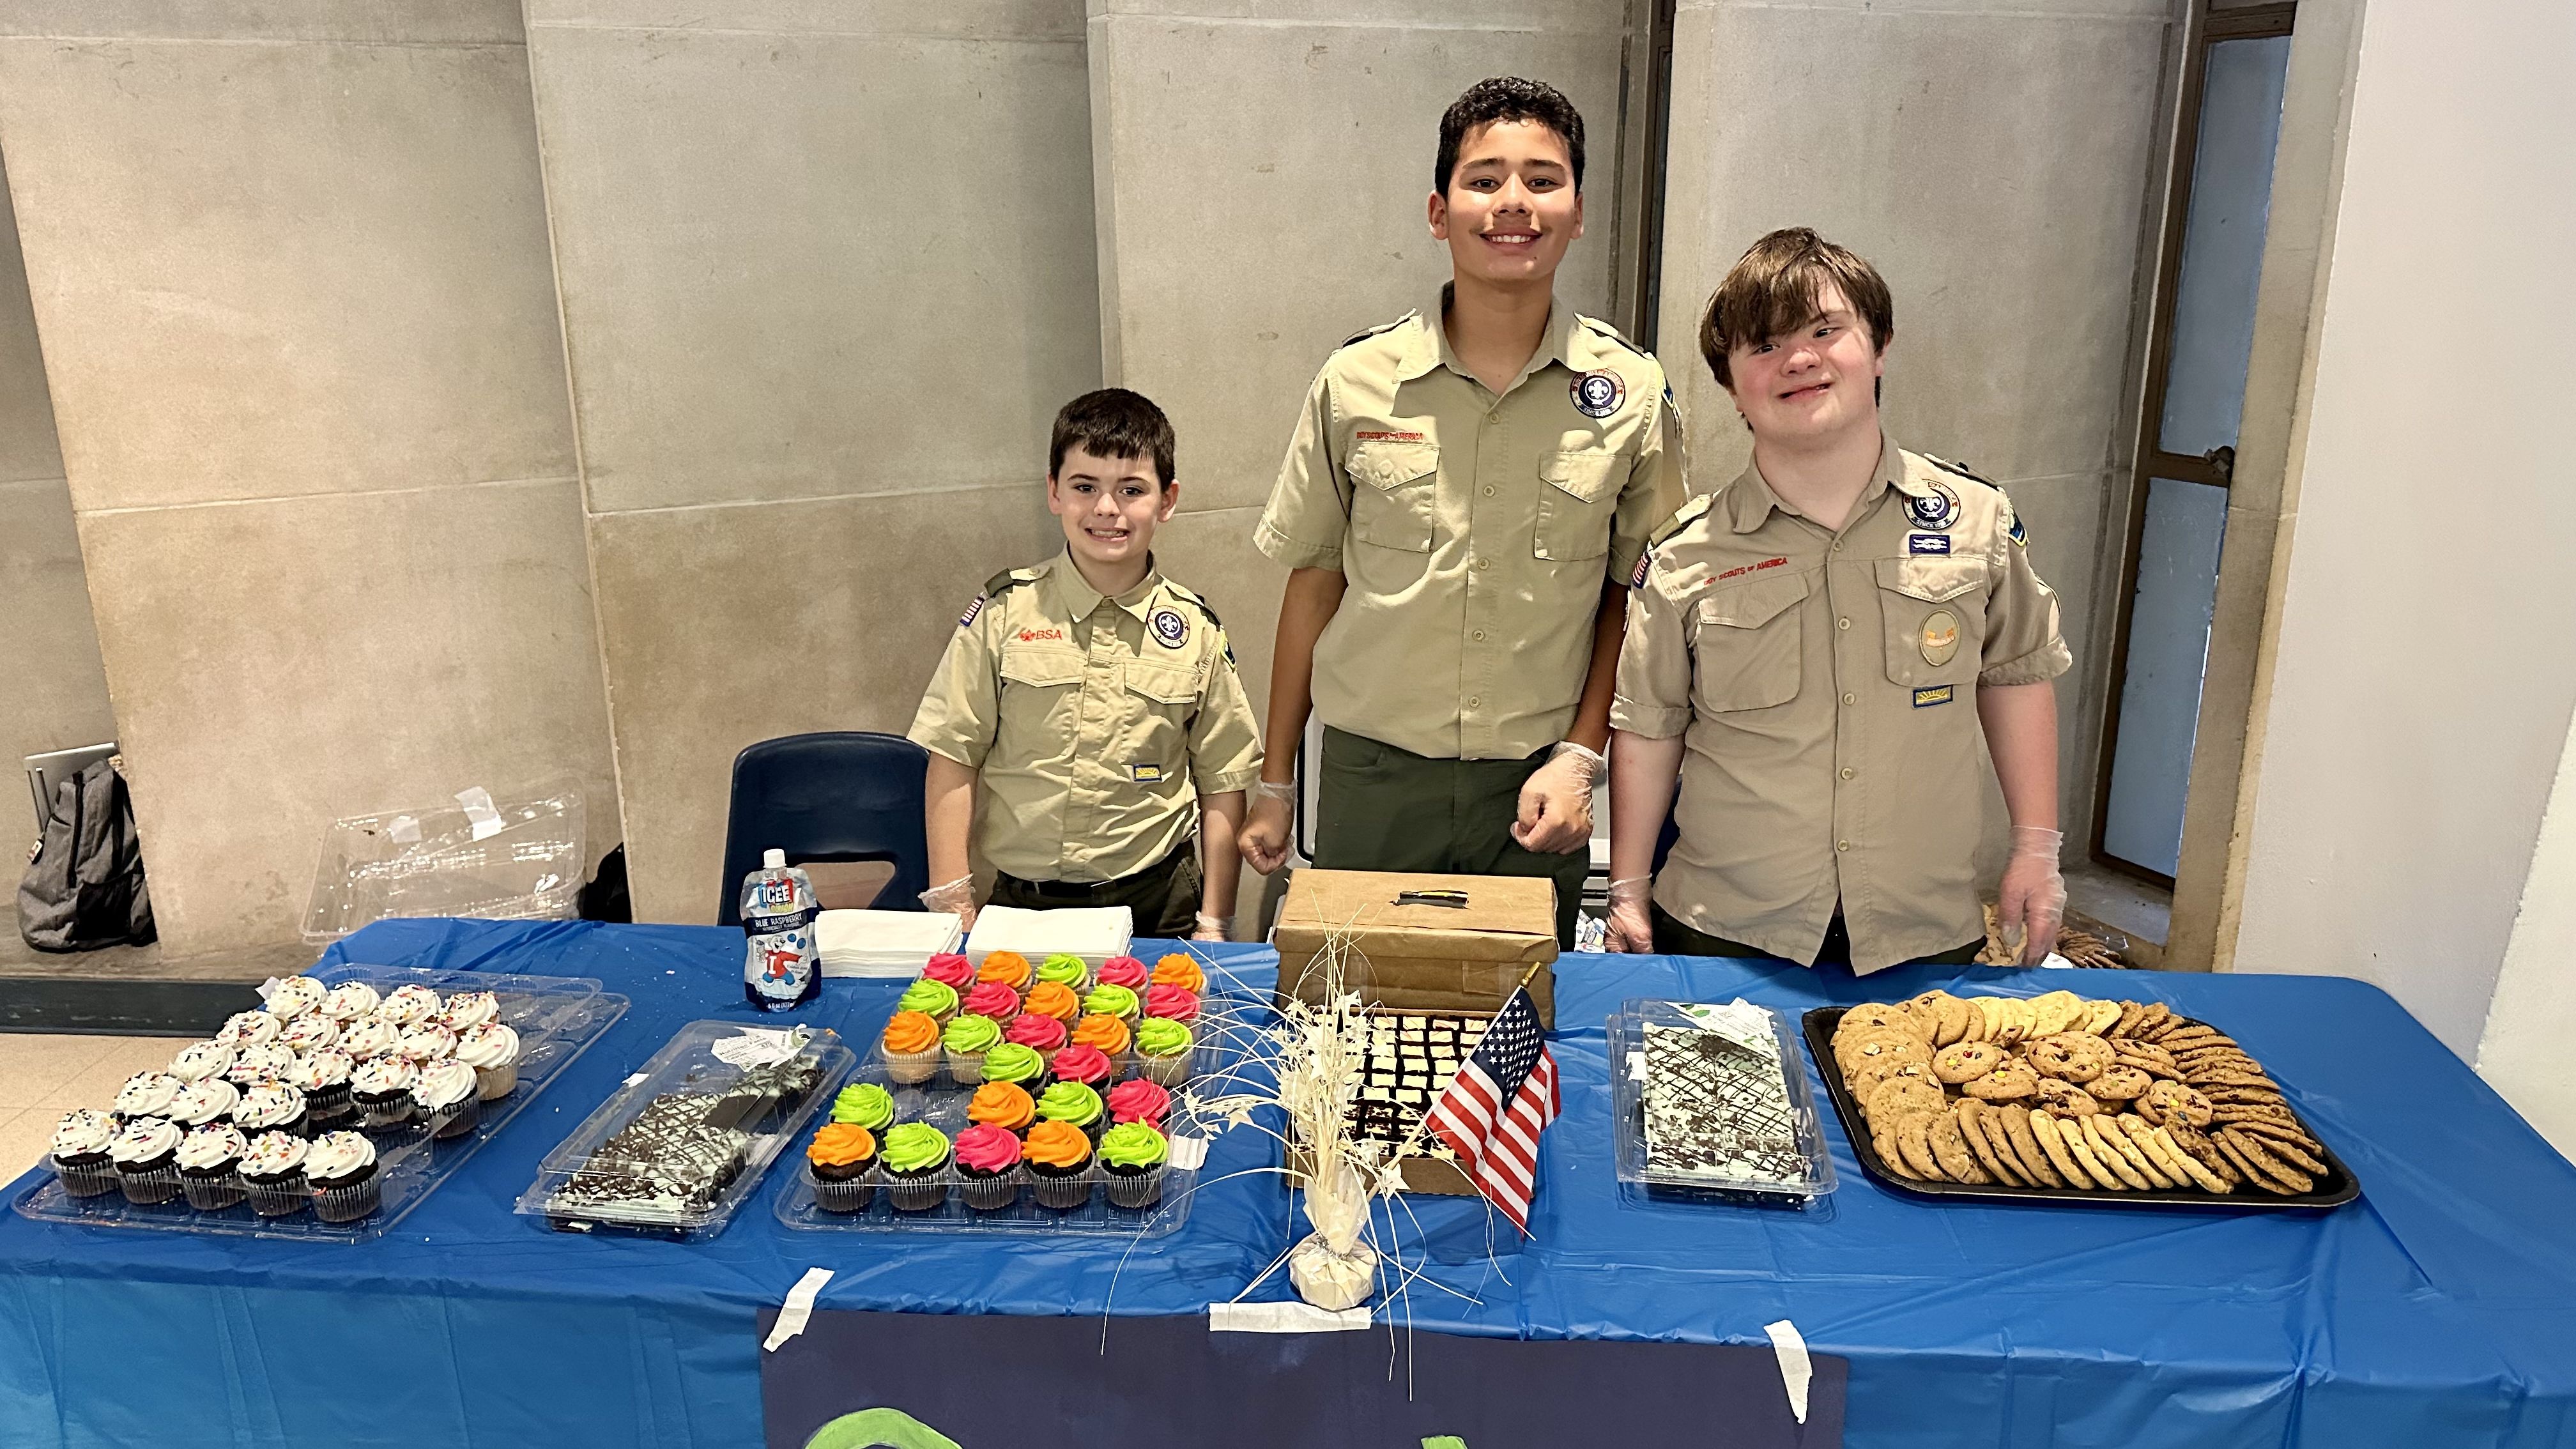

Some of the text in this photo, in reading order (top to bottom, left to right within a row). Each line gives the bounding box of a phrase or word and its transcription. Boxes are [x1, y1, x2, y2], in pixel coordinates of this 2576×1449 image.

[1703, 576, 1717, 586] BOY
[1719, 567, 1745, 580] SCOUTS
[1756, 557, 1788, 571] AMERICA
[1036, 629, 1062, 640] BSA
[762, 885, 790, 903] ICEE
[755, 919, 769, 928] BLUE
[770, 912, 802, 926] RASPBERRY
